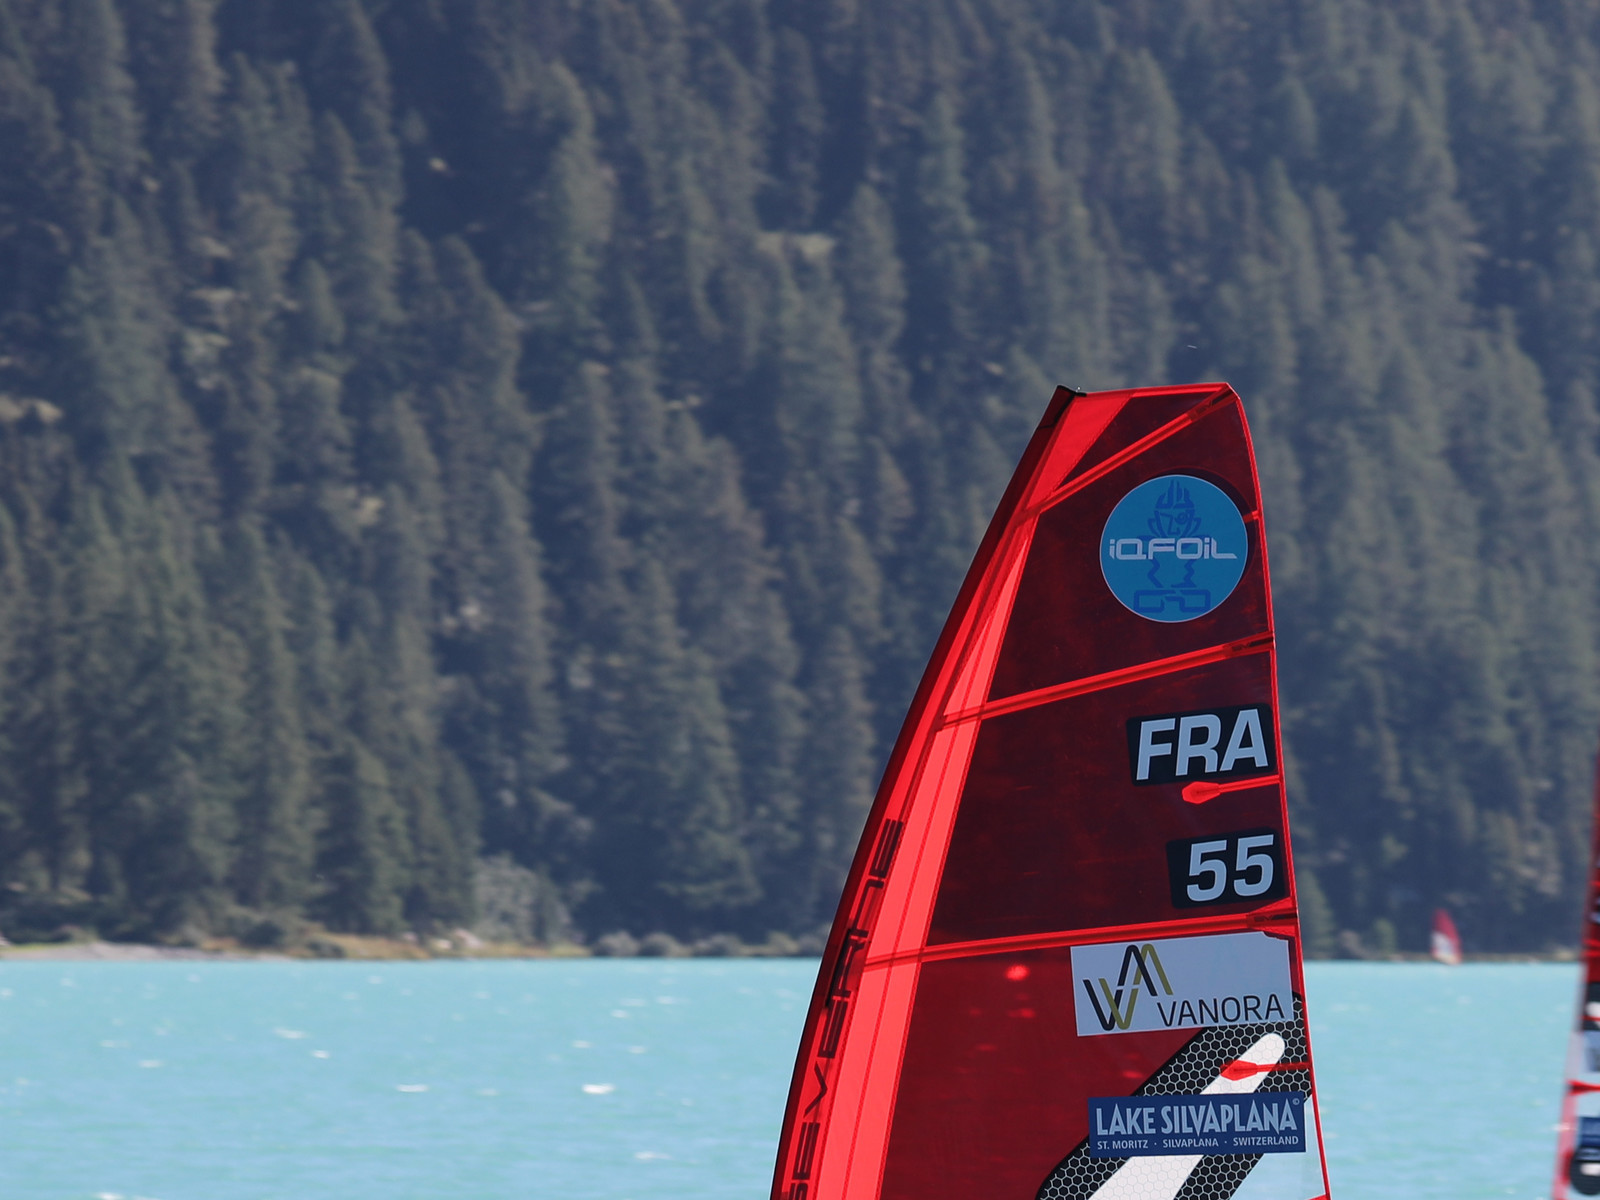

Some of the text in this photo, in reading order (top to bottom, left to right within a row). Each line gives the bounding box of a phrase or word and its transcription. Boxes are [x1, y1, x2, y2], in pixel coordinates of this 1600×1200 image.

[1136, 708, 1269, 781] FRA
[1186, 834, 1275, 902] 55
[1156, 993, 1285, 1027] VANORA
[1096, 1102, 1156, 1136] LAKE
[1097, 1135, 1299, 1150] ST. MORITZ SILVAPLANA SWITZERLAND
